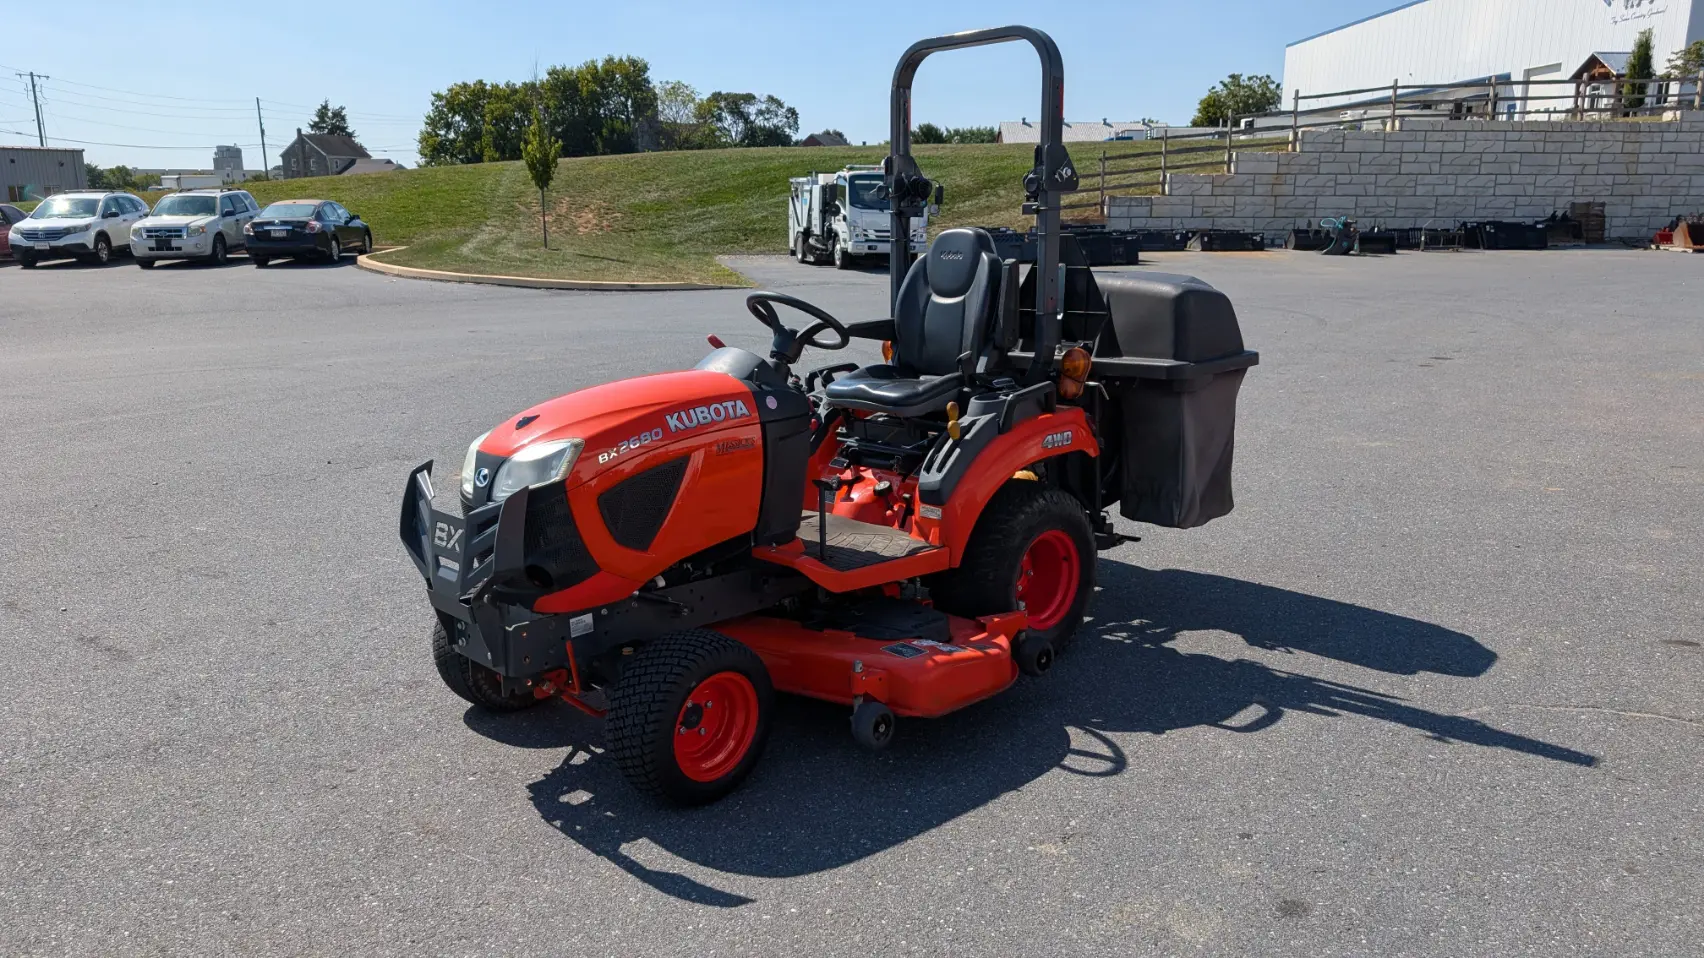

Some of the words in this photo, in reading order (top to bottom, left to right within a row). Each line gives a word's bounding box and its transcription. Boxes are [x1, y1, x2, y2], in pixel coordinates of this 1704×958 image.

[665, 399, 751, 433] KUBOTA
[598, 427, 663, 464] BX2680
[1042, 430, 1072, 449] 4WD
[434, 521, 464, 553] BX
